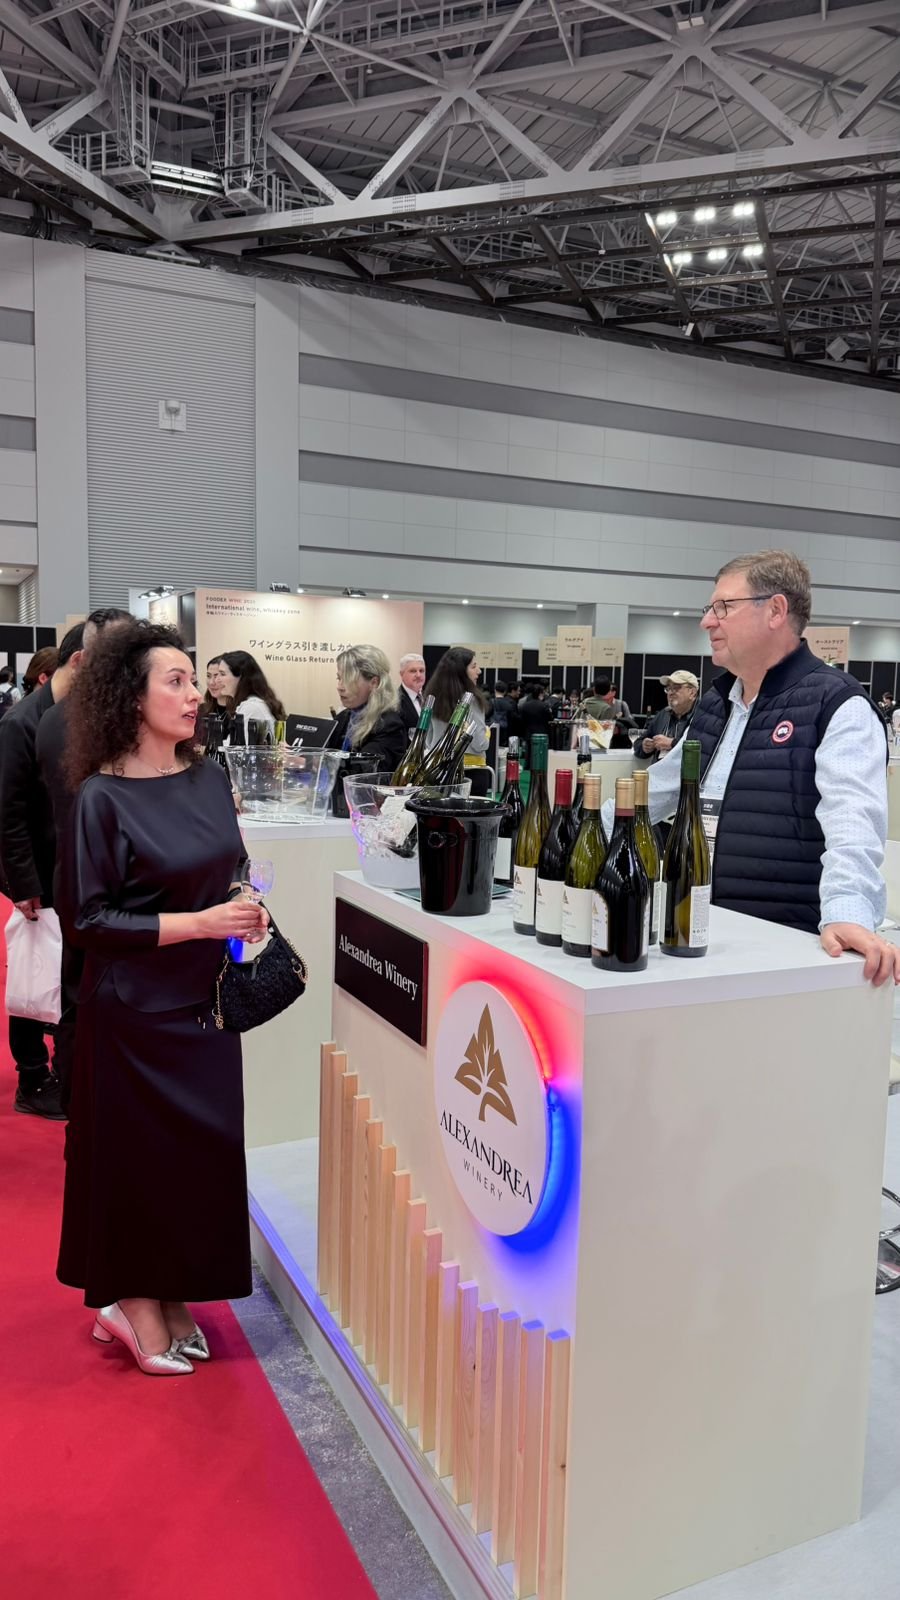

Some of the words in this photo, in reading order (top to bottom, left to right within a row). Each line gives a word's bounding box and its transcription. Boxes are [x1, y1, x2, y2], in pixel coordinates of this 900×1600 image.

[206, 603, 245, 611] International
[339, 933, 383, 975] Alexandrea
[384, 960, 418, 1001] Winery
[440, 1109, 533, 1205] ALEXANDREA
[463, 1158, 503, 1201] WINERY
